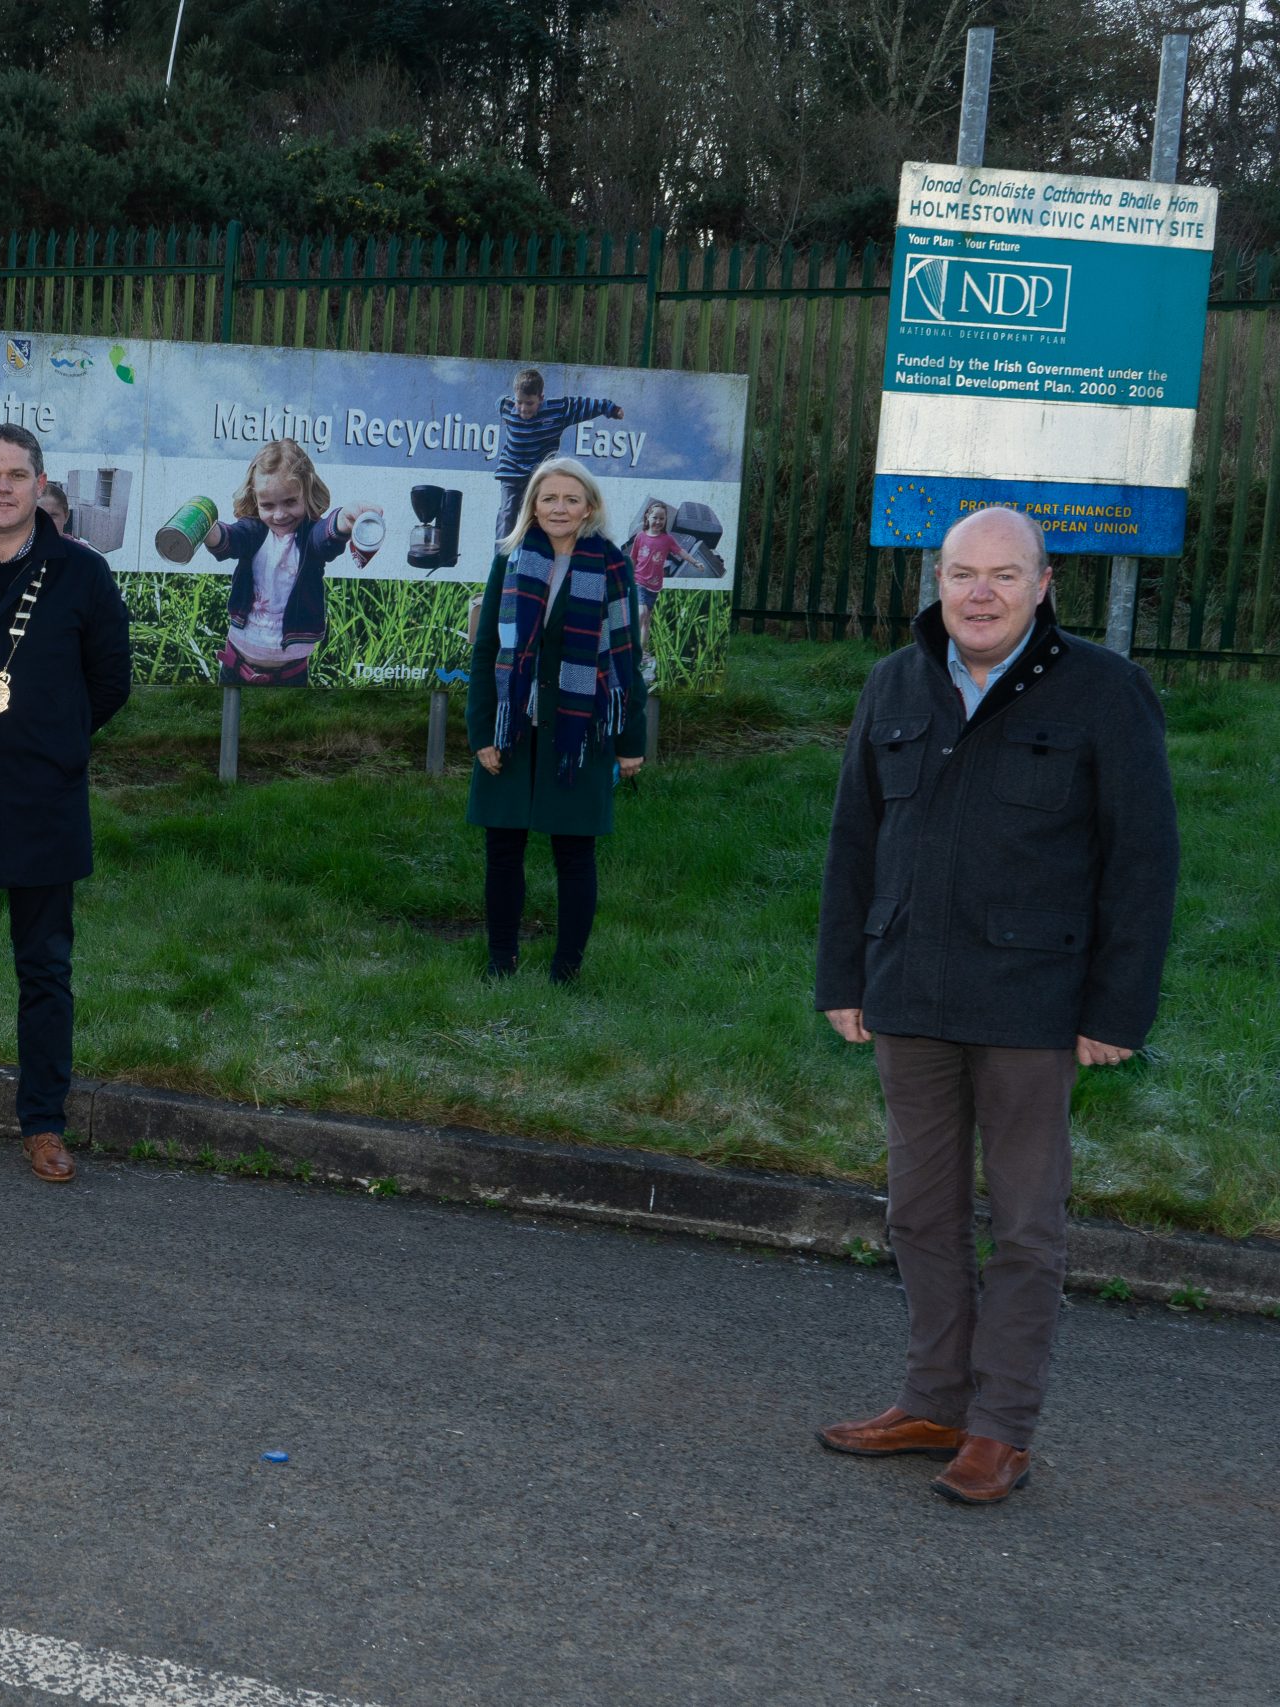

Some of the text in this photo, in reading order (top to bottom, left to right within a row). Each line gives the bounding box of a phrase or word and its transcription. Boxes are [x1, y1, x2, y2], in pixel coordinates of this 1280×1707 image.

[921, 175, 1199, 214] Ionad Conláiste Cathartha Bhaile Hóm
[910, 200, 1204, 239] HOLMESTOWN CIVIC AMENITY SITE
[908, 233, 931, 246] Your
[933, 235, 954, 247] Plan
[965, 238, 986, 250] Your
[989, 239, 1021, 252] Future
[958, 270, 1053, 317] NDP
[899, 326, 1067, 345] NATIONAL DEVELOPMENT PLAN
[897, 353, 1168, 382] Funded by the Irish Government under the
[895, 371, 951, 386] National
[955, 374, 1040, 392] Development
[1044, 380, 1075, 394] Plan.
[1079, 382, 1117, 396] 2000
[1128, 385, 1165, 399] 2006
[213, 403, 647, 467] Making Recycling Easy
[1025, 503, 1133, 518] PART-FINANCED
[1039, 520, 1138, 535] OPEAN UNION
[354, 662, 429, 683] Together
